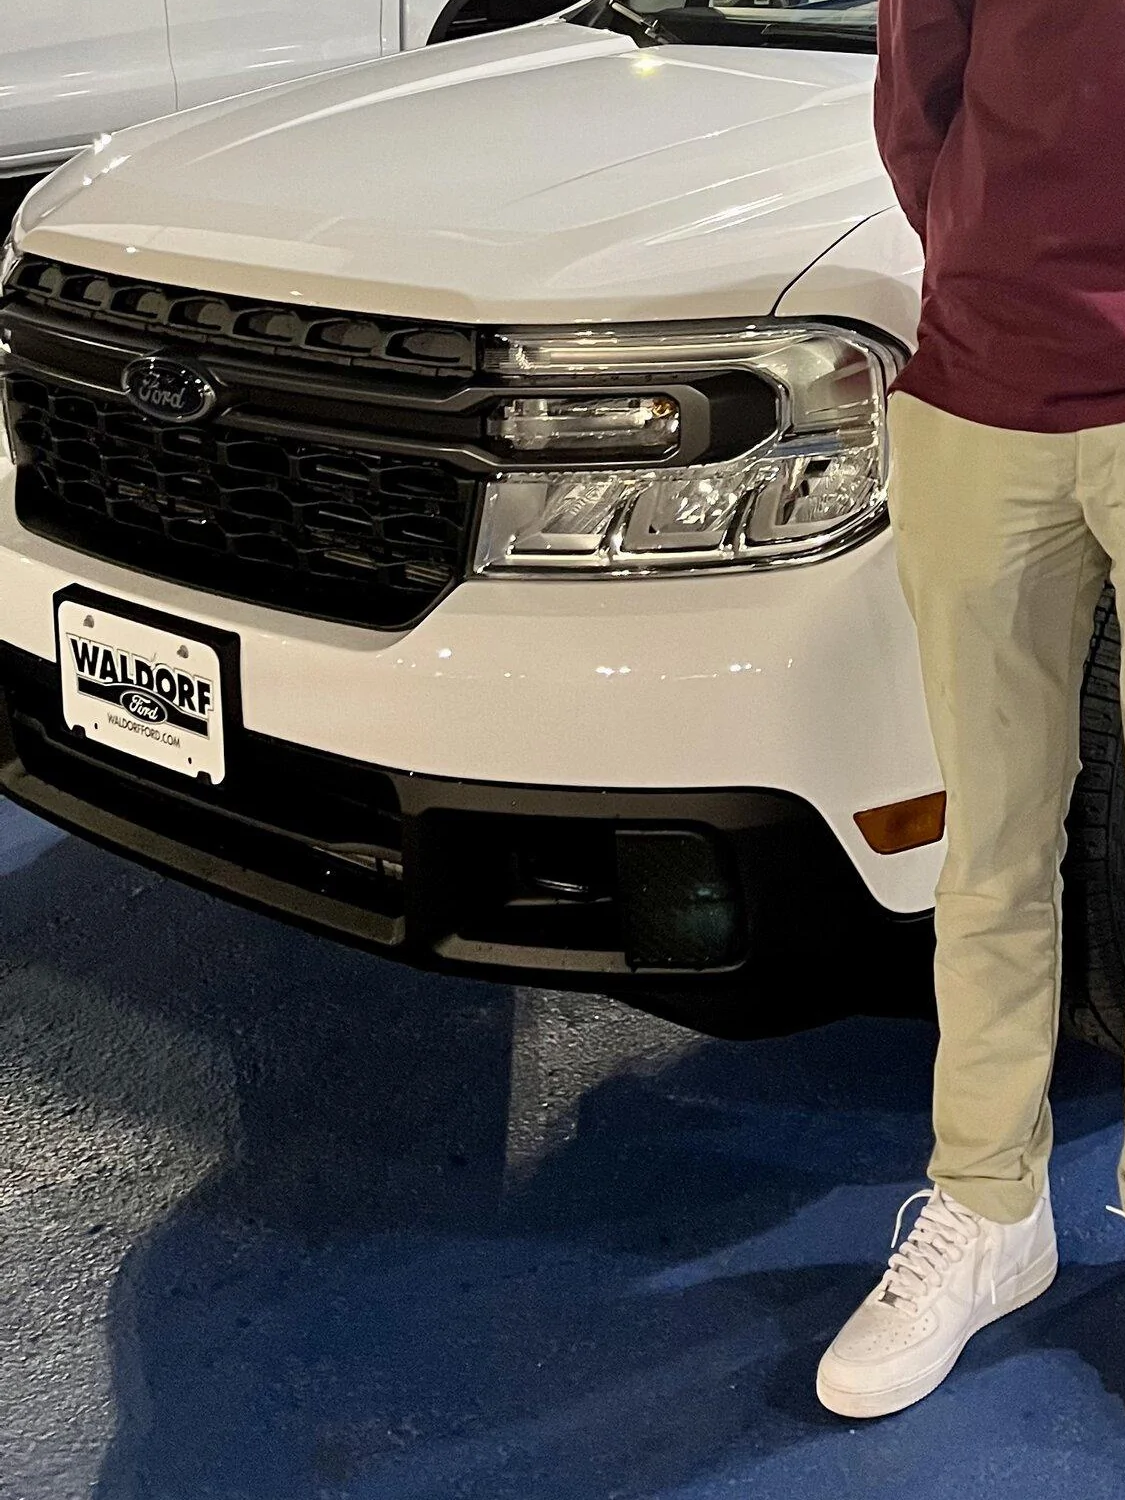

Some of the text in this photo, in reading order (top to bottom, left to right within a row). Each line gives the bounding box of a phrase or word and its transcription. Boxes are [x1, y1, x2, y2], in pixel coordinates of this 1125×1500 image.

[139, 372, 186, 409] Ford
[69, 637, 211, 715] WALDORF
[129, 695, 159, 720] Ford
[106, 711, 181, 748] WALDORFFORD.COM
